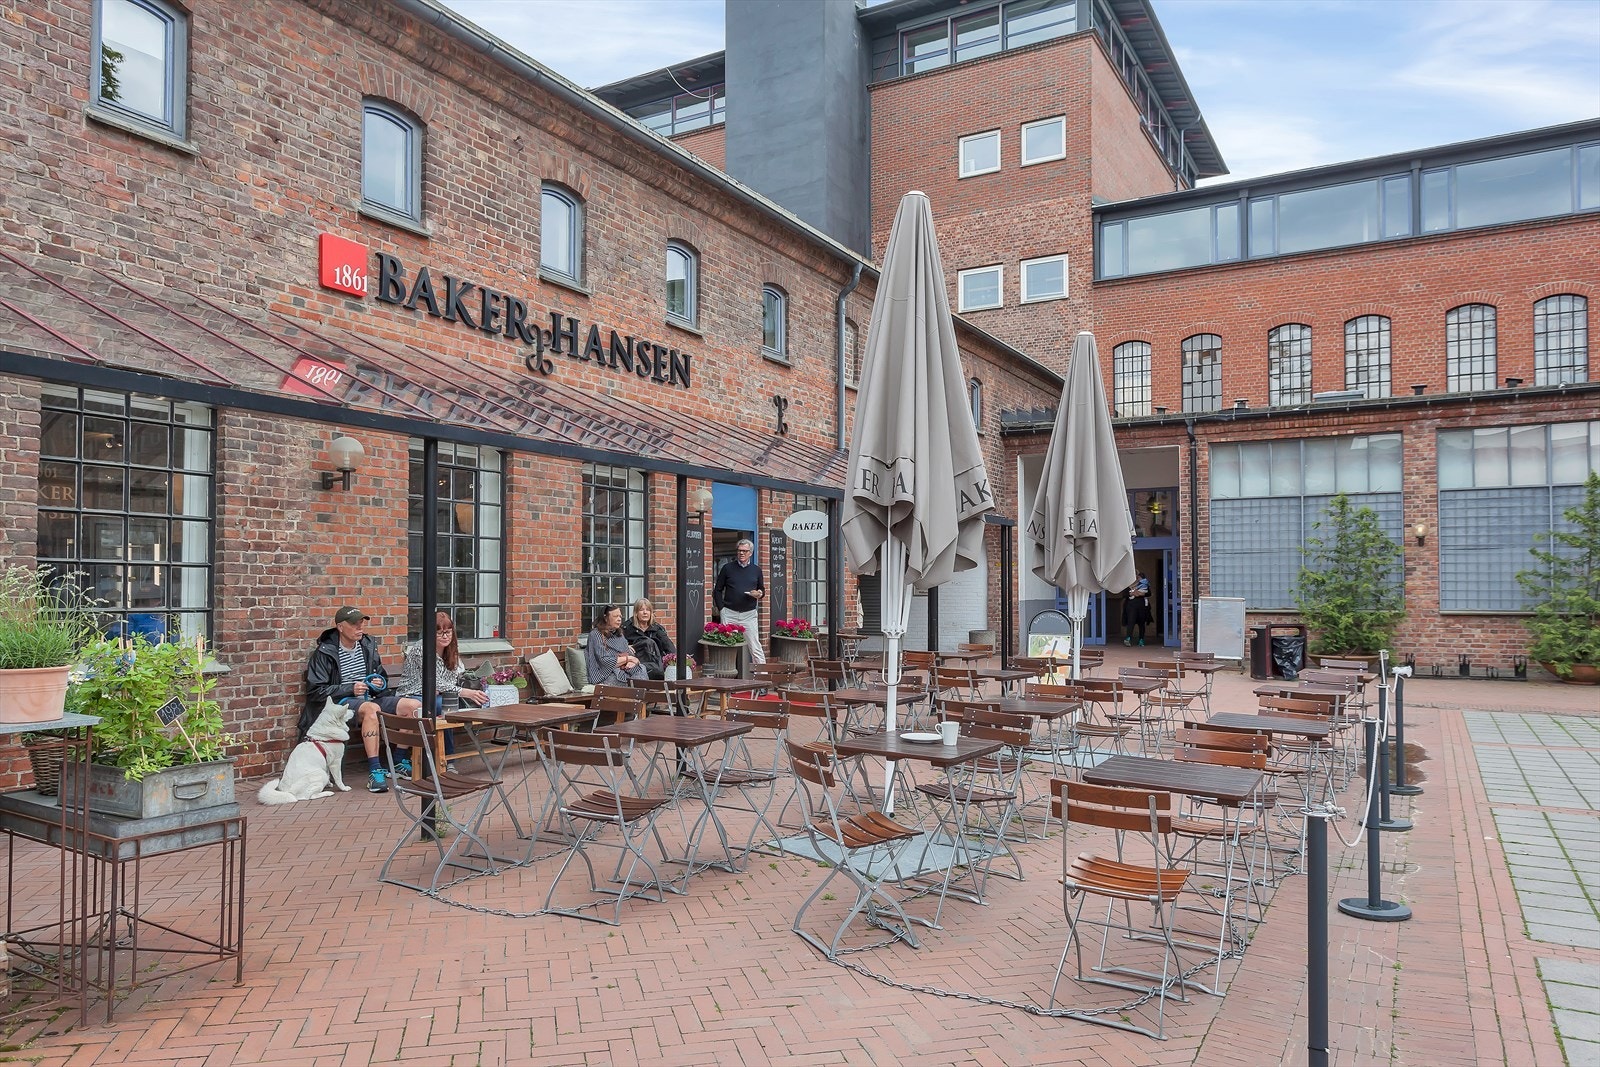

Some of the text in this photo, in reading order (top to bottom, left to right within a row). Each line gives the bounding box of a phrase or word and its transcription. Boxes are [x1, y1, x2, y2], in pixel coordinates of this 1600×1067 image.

[334, 264, 368, 293] 1861
[374, 251, 692, 389] BAKER HANSEN
[854, 468, 880, 498] ER
[791, 521, 824, 531] BAKER
